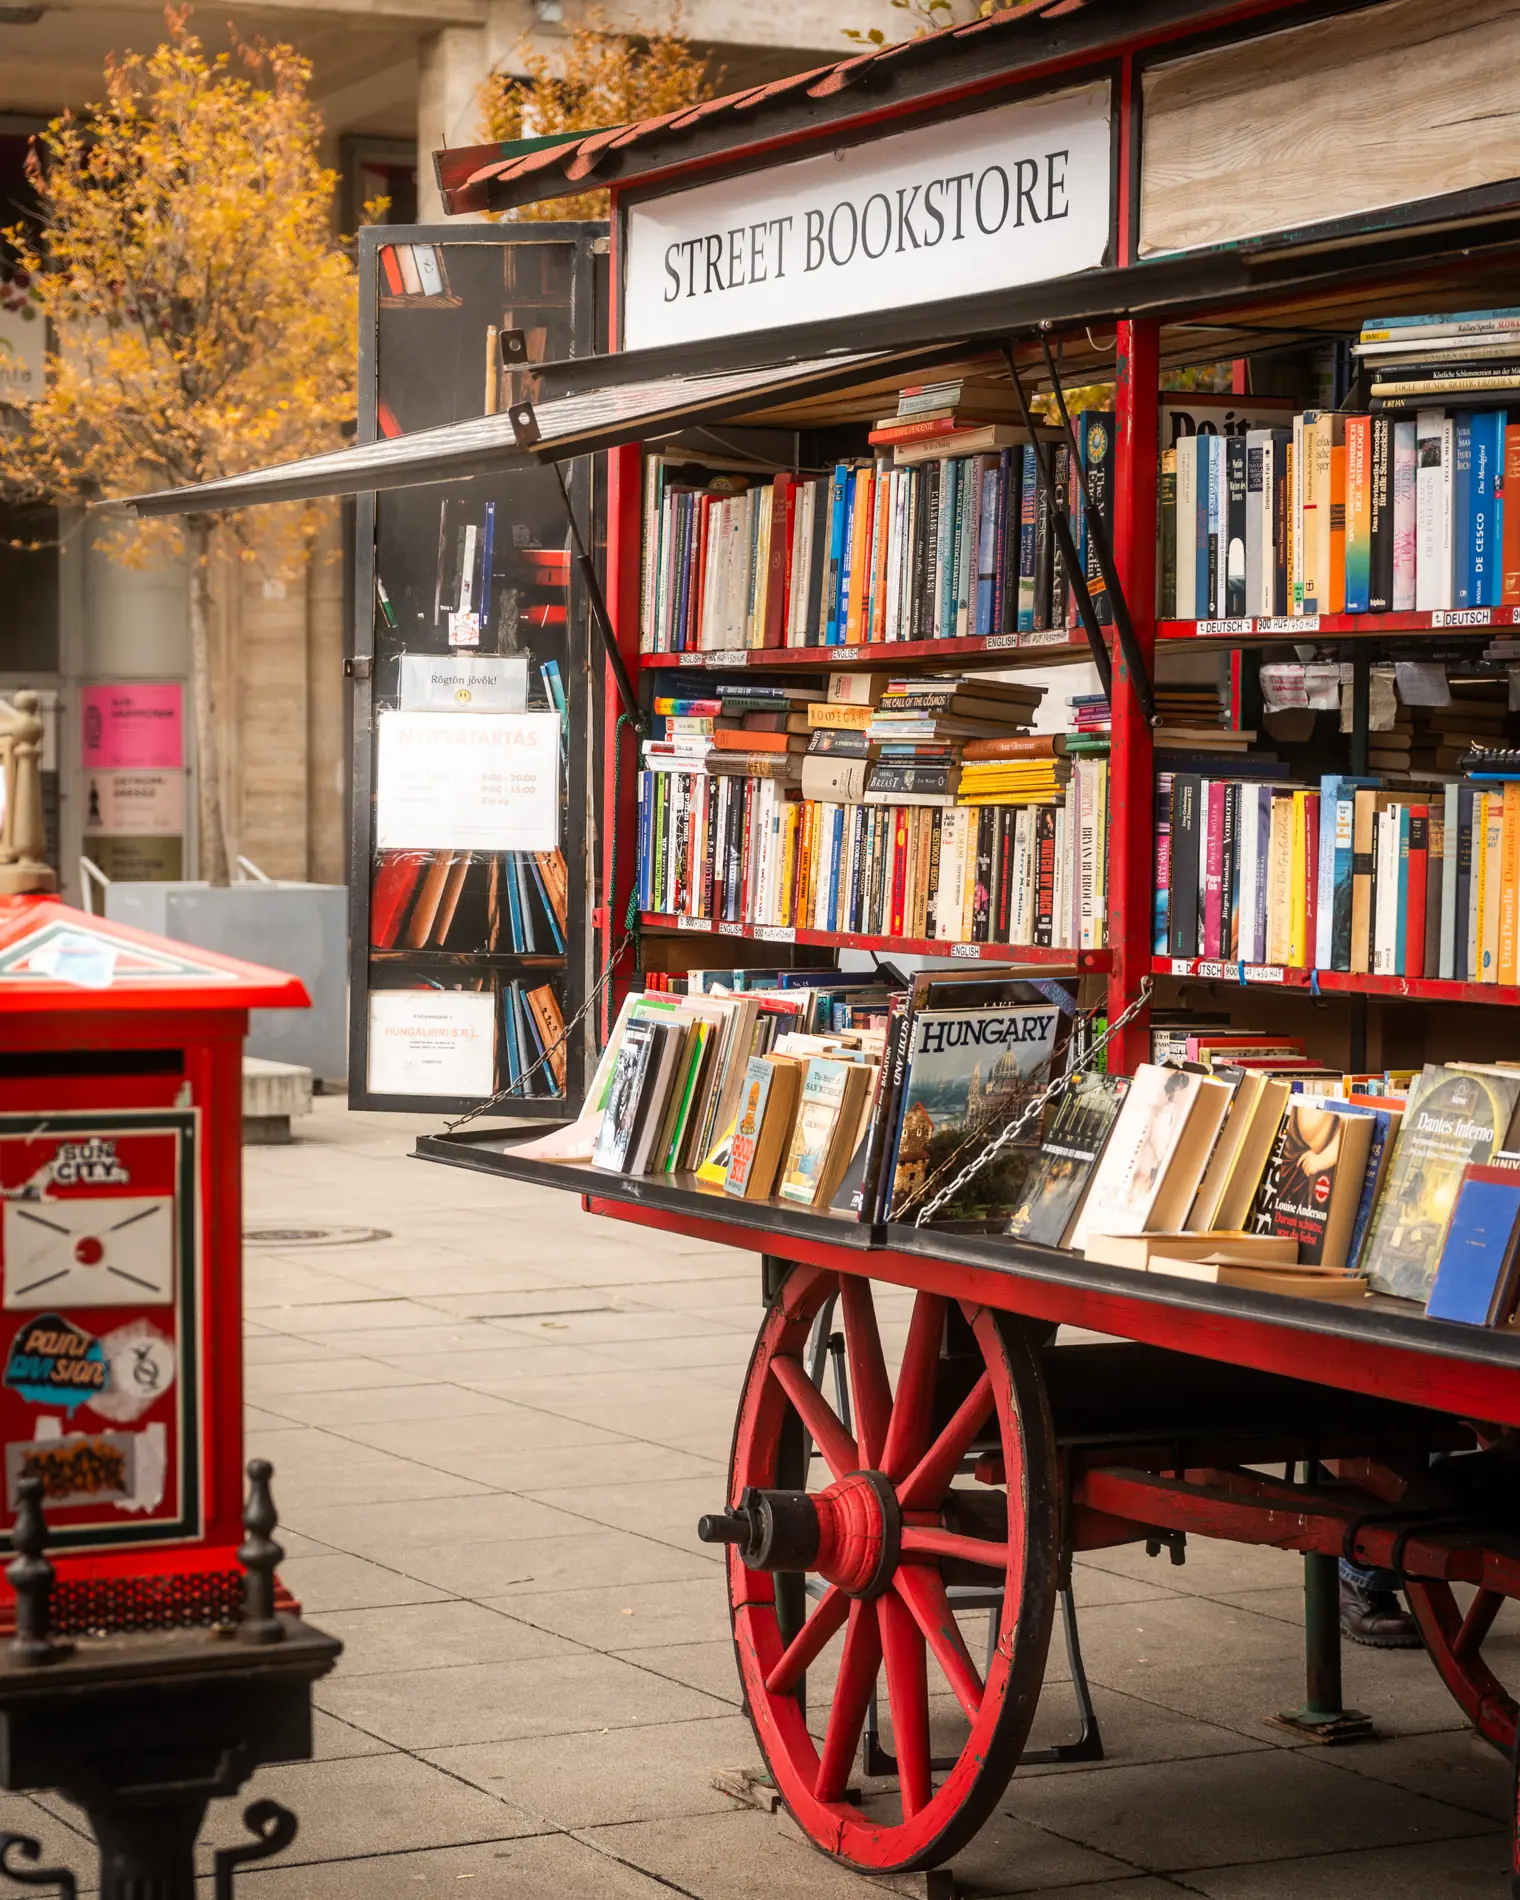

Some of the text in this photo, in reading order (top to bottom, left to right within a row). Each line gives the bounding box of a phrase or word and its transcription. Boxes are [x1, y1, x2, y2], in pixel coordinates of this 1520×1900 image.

[663, 149, 1071, 303] STREET BOOKSTORE
[1356, 423, 1365, 485] ASTROLOGIE
[1379, 420, 1389, 506] für alle Sternzeichen
[1478, 444, 1487, 480] Mondpferd
[1371, 420, 1382, 533] Das individuelle Horoskop
[1401, 459, 1411, 481] DIR
[1023, 450, 1036, 520] JIMMY BUFFETT
[1401, 484, 1411, 500] ZU
[1038, 489, 1048, 545] MUSIC
[1425, 476, 1434, 532] FREUNDIN
[926, 490, 939, 594] CRISIS RESPONSE
[1475, 513, 1485, 552] CESCO
[952, 529, 961, 600] HISTOCHEMISTRY
[1475, 556, 1484, 573] DE
[1206, 621, 1243, 633] DEUTSCH
[1258, 619, 1271, 630] 900
[1445, 611, 1489, 625] DEUTSCH
[832, 649, 858, 659] ENGLISH
[987, 636, 1016, 648] ENGLISH
[680, 654, 701, 664] ENGLISH
[881, 696, 891, 709] THE
[892, 696, 904, 708] CALL
[913, 695, 923, 706] THE
[817, 710, 857, 724] OMEGA
[870, 776, 900, 788] BREAST
[803, 804, 813, 848] Castaway
[855, 810, 863, 841] CATHERINE
[801, 852, 809, 872] LUCY
[853, 842, 861, 870] COOKSON
[930, 828, 940, 890] CRESTWOOD HEIGHTS
[1222, 787, 1232, 919] Jürgen Heimbach VORBOTEN
[1039, 839, 1054, 915] WATCH MY BACK
[1081, 828, 1093, 918] BRYAN BURROUGH
[1501, 787, 1516, 967] Utta Danella Die andere Eva
[1016, 877, 1024, 925] McMillan
[719, 923, 742, 935] ENGLISH
[754, 928, 764, 937] 900
[951, 945, 980, 957] ENGLISH
[1226, 967, 1237, 975] 900
[385, 1026, 449, 1038] HUNGALIBRI
[918, 1015, 1055, 1054] HUNGARY
[880, 1045, 892, 1088] BALATON
[893, 1020, 909, 1086] SCOTLAND
[1417, 1111, 1494, 1142] Dantes Inferno
[57, 1160, 119, 1181] CITY
[1491, 1158, 1520, 1170] UNIV
[1273, 1211, 1297, 1226] Darum
[1275, 1198, 1327, 1221] Louise Anderson
